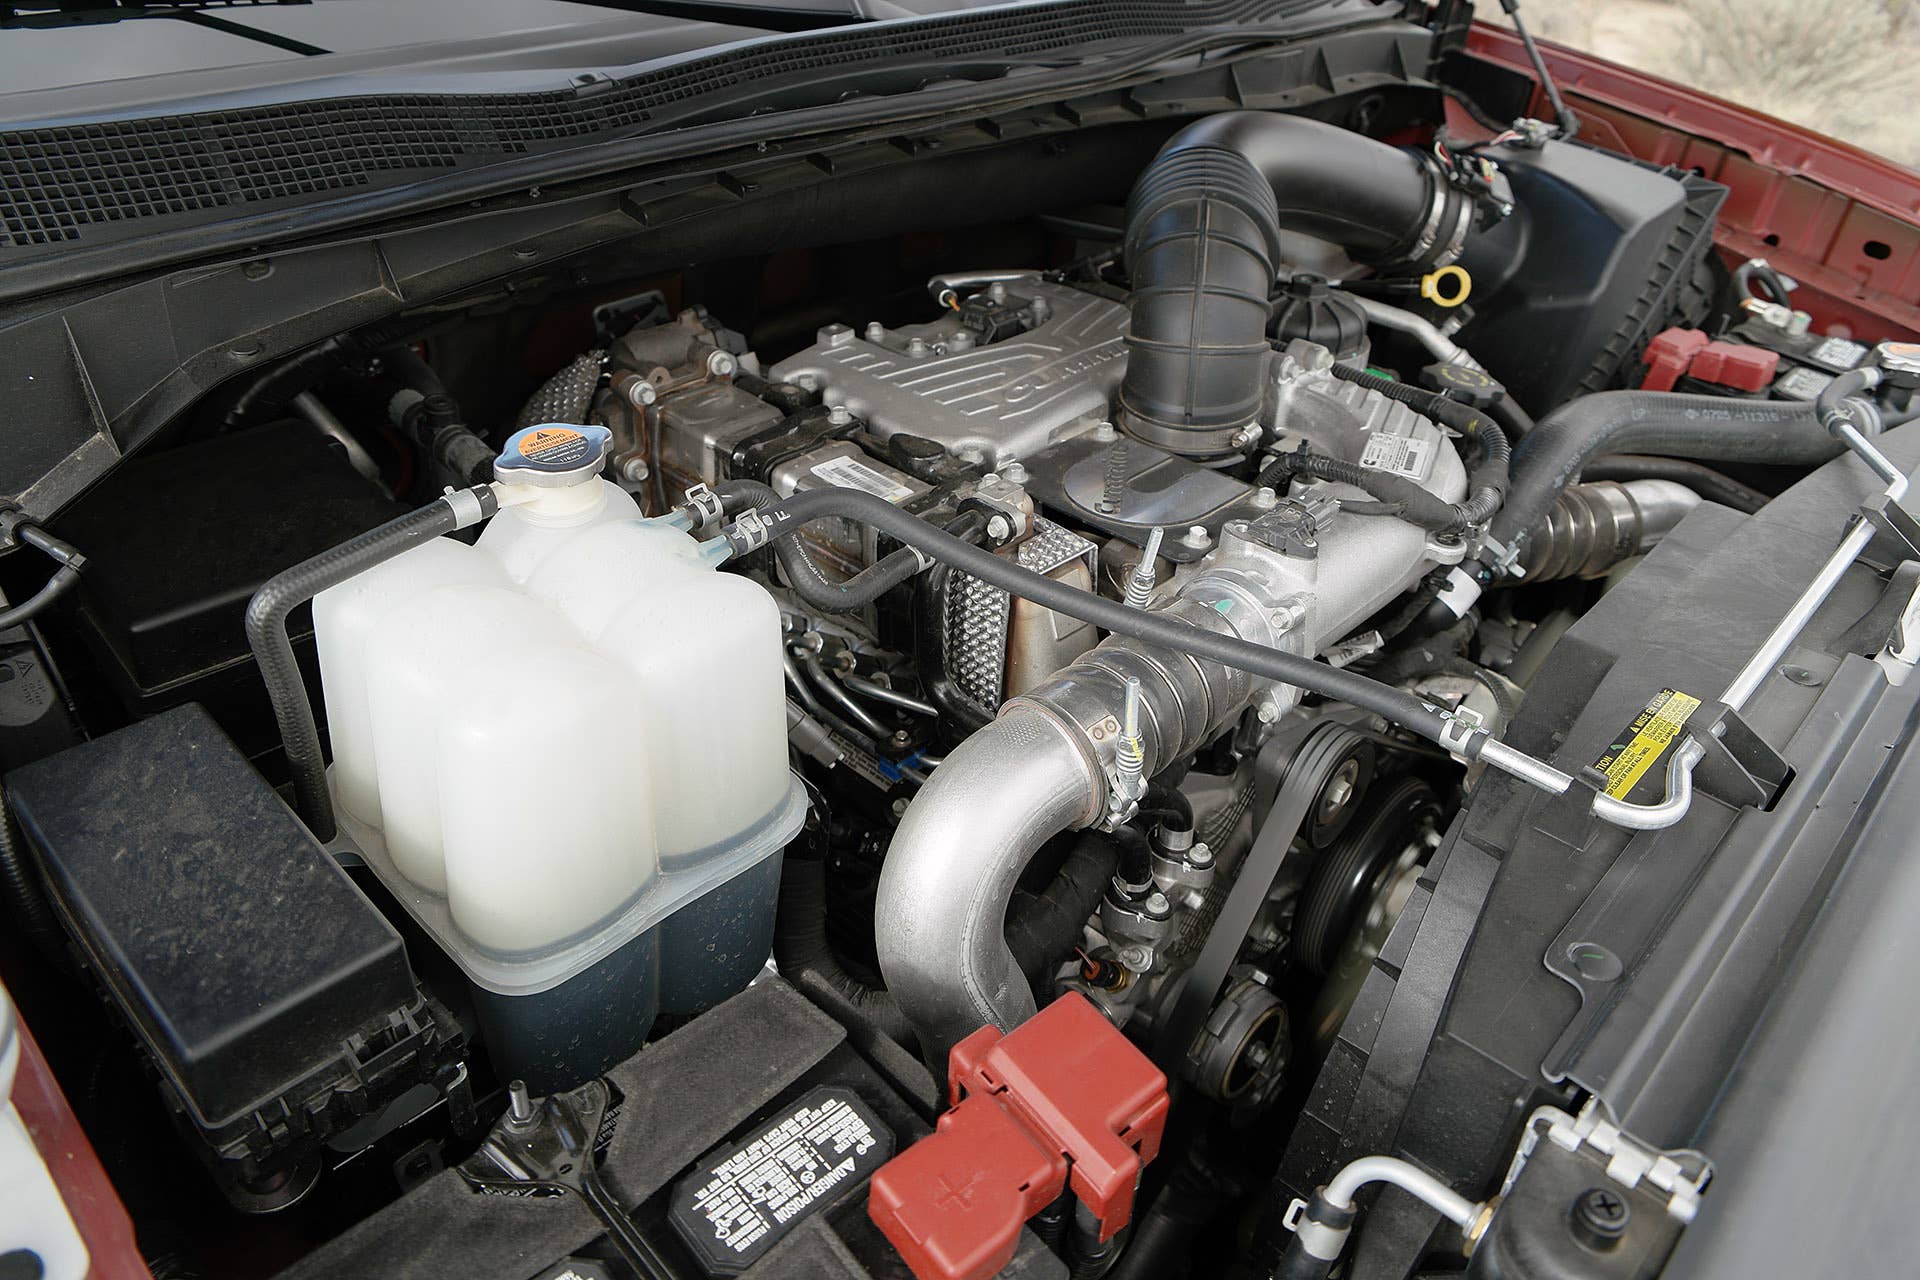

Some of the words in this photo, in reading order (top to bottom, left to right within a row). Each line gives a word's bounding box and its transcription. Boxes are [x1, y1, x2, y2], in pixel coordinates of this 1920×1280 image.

[1634, 712, 1652, 727] MISE
[1595, 755, 1614, 771] TION
[772, 1165, 848, 1224] DANGER/POISON
